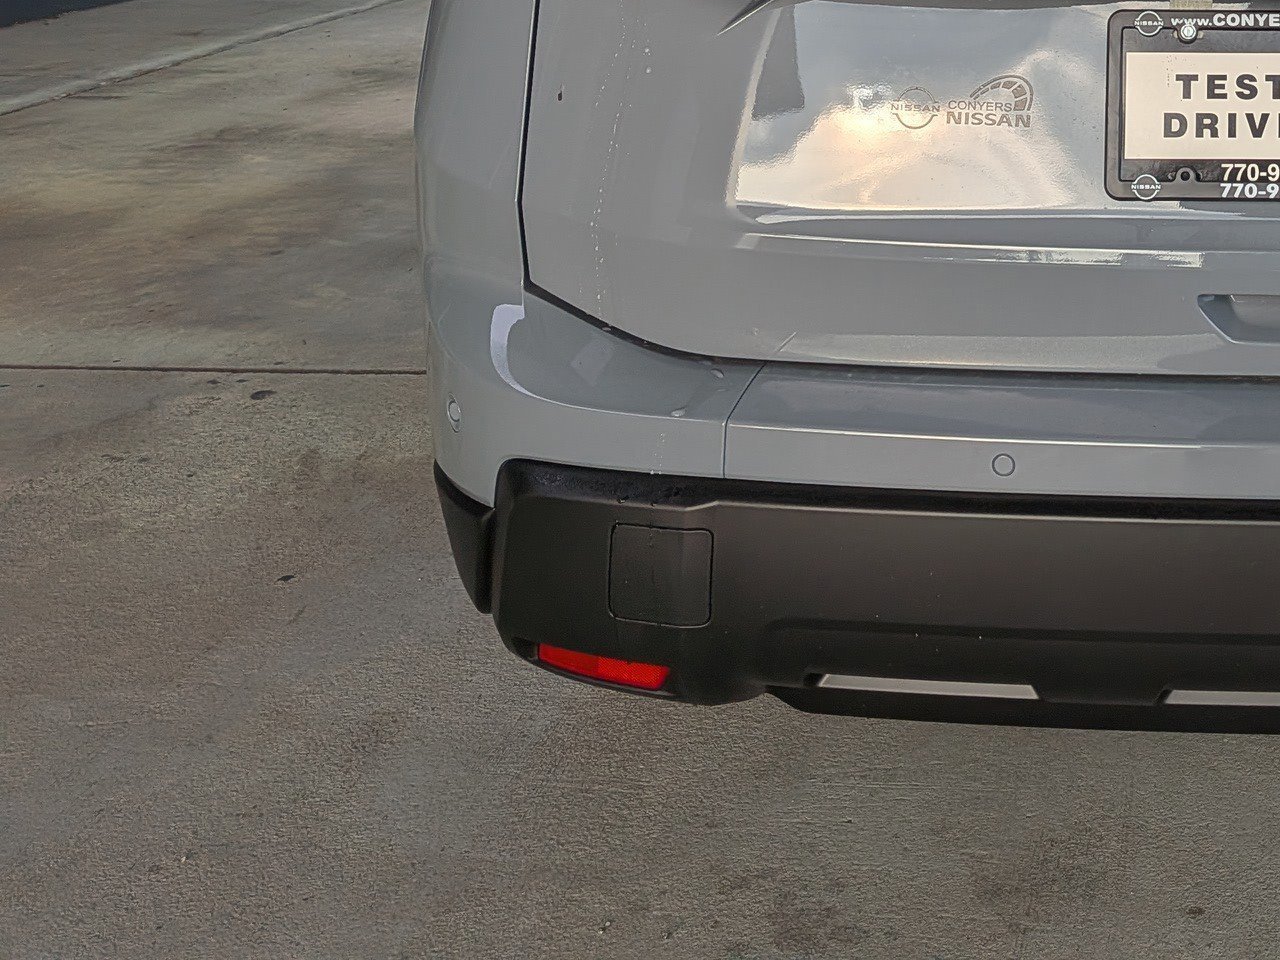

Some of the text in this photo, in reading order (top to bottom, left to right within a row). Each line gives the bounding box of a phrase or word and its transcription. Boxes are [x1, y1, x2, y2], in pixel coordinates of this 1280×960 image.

[890, 103, 941, 113] NISSAN
[948, 100, 1013, 112] CONYERS
[946, 111, 1031, 128] NISSAN
